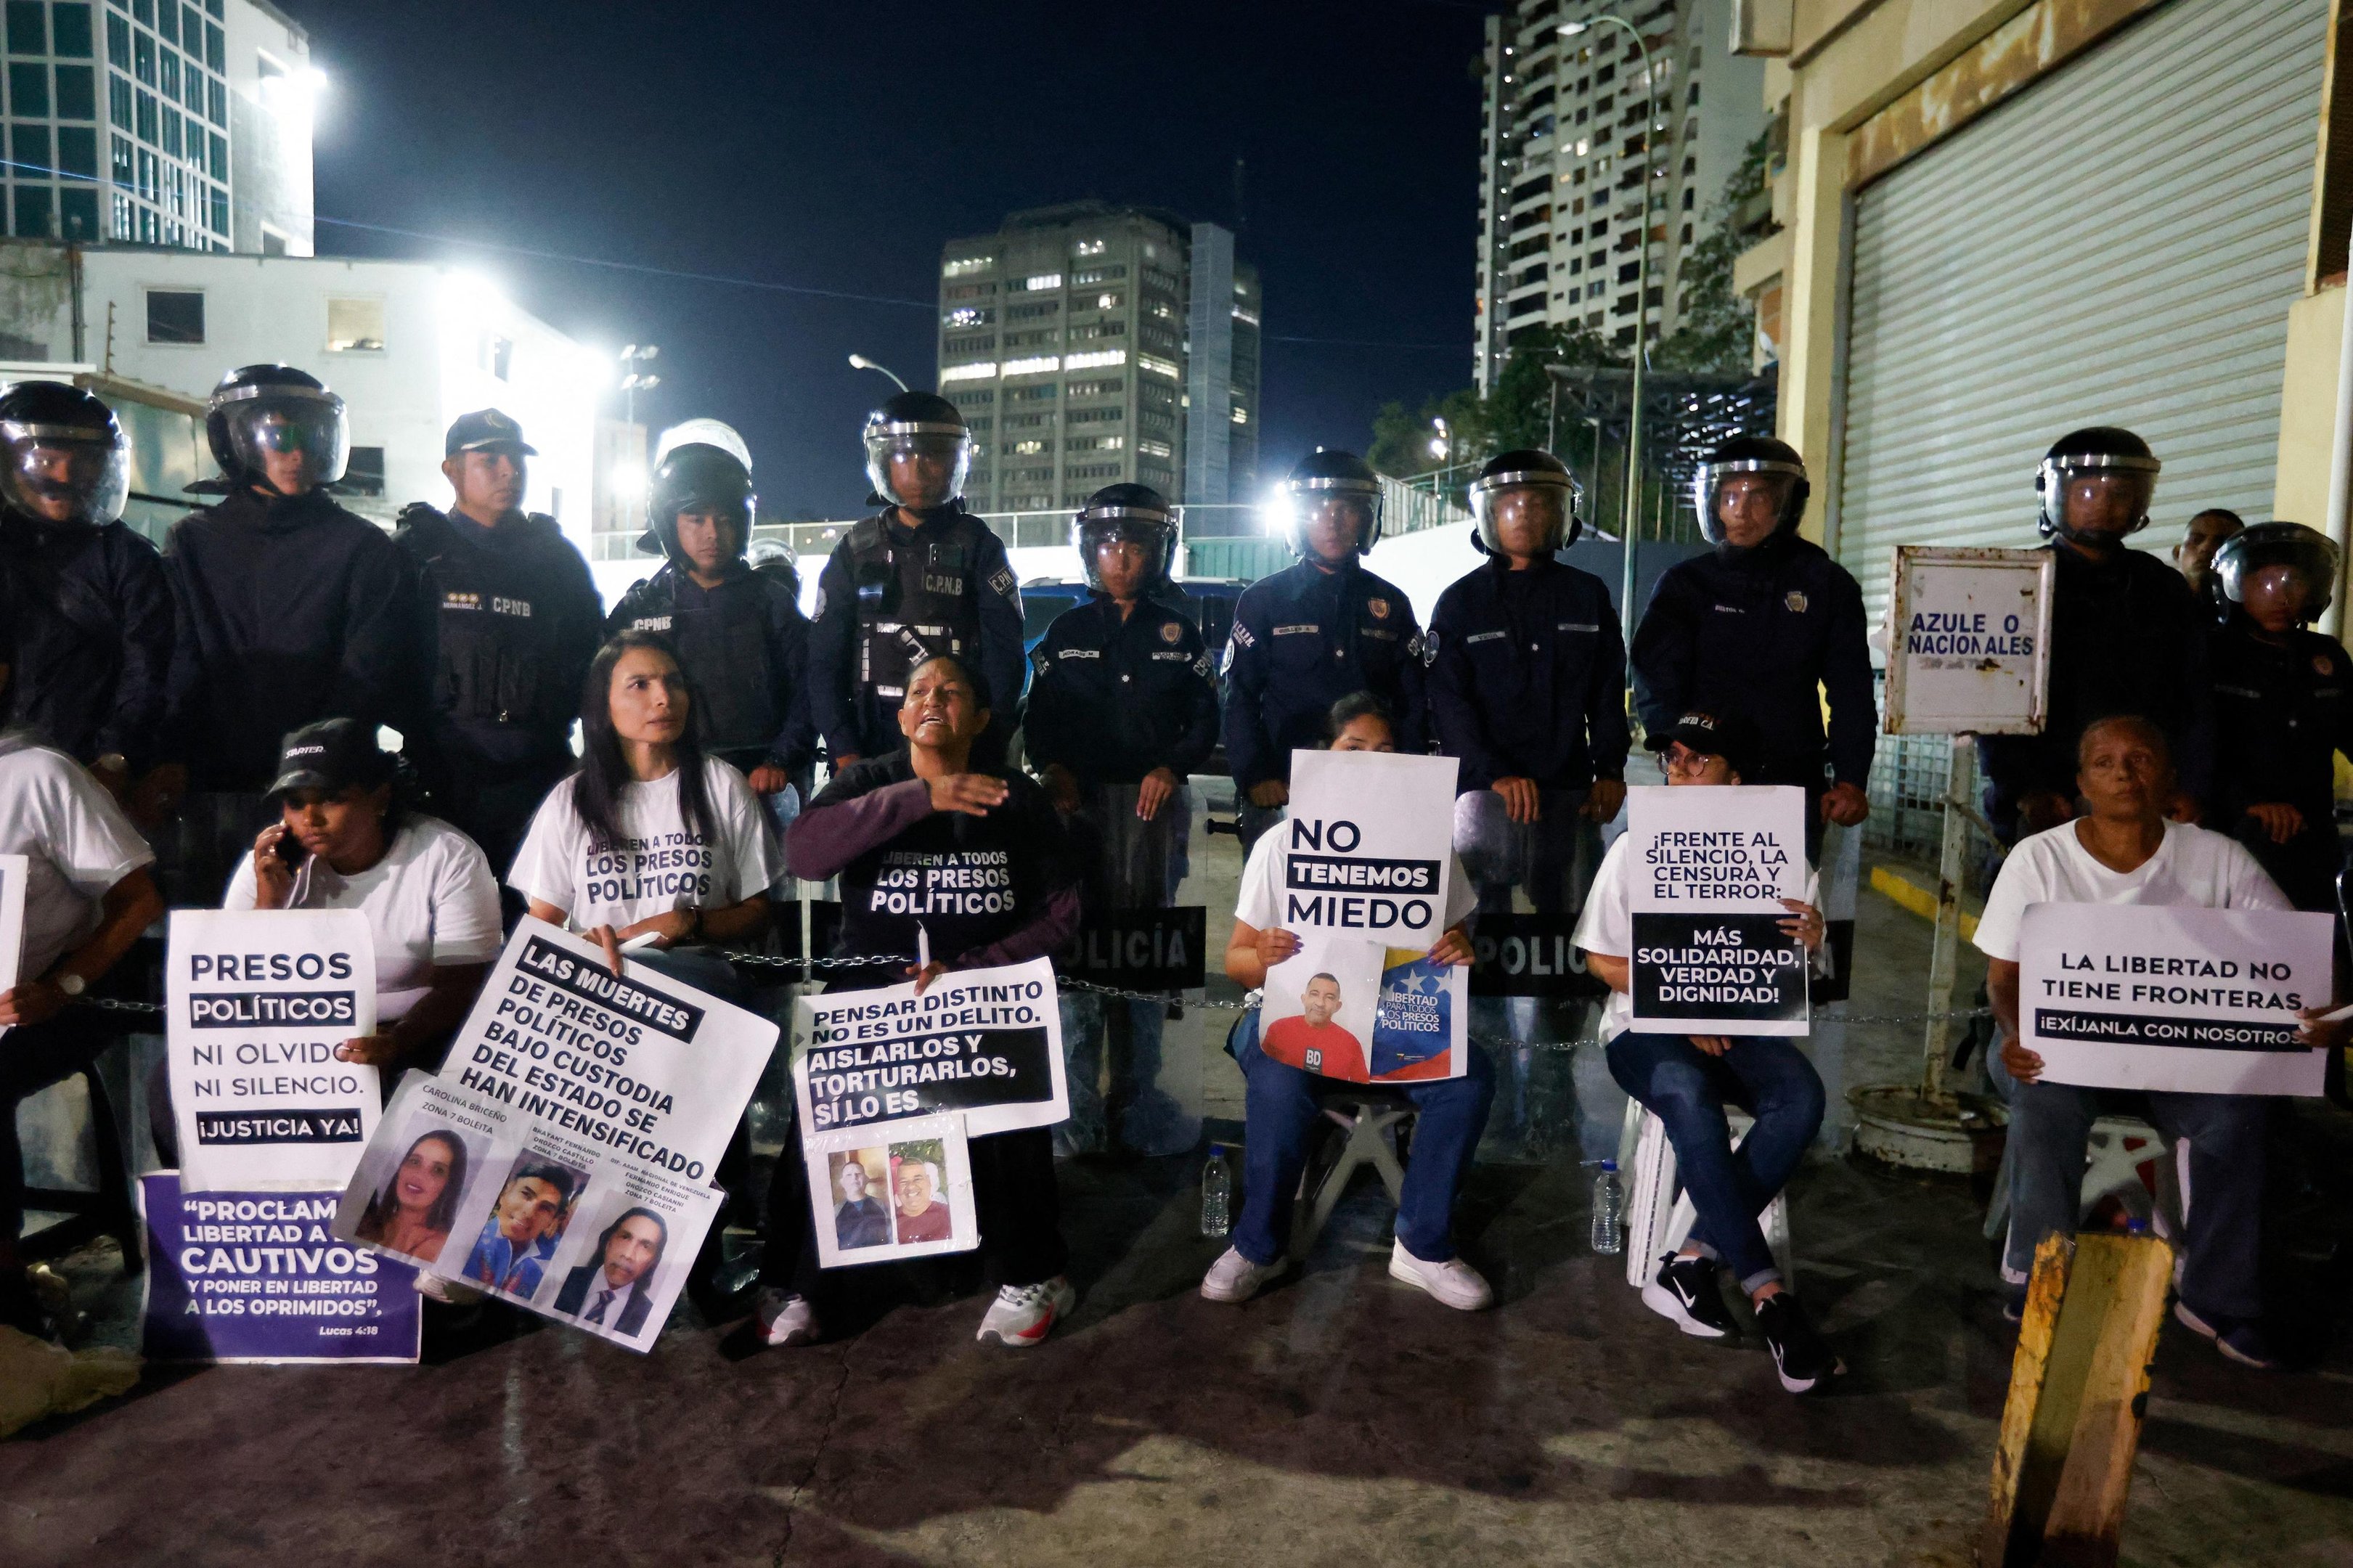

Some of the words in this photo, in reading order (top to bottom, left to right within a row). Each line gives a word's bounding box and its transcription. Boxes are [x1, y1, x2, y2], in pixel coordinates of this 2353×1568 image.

[926, 574, 963, 596] C.P.N.B
[494, 597, 531, 617] CPNB
[1911, 613, 1986, 633] AZULE
[2004, 615, 2019, 634] O
[285, 746, 324, 759] STARTER
[653, 836, 661, 848] A
[1292, 818, 1361, 852] NO
[1654, 832, 1744, 850] ¡FRENTE
[1751, 832, 1780, 846] AL
[587, 855, 627, 877] LOS
[635, 849, 712, 873] PRESOS
[947, 853, 958, 865] A
[962, 852, 1008, 865] TODOS
[1646, 849, 1753, 867] SILENCIO,
[1761, 849, 1788, 864] LA
[877, 868, 918, 888] LOS
[926, 867, 1010, 888] PRESOS
[1293, 862, 1429, 887] TENEMOS
[1655, 867, 1761, 881] CENSURA
[1766, 867, 1780, 881] Y
[588, 873, 711, 904] POLÍTICOS
[1655, 884, 1679, 899] EL
[1685, 884, 1781, 899] TERROR:
[871, 888, 1015, 914] POLÍTICOS
[1288, 894, 1432, 930] MIEDO
[1062, 922, 1188, 968] OLICÍA
[1694, 926, 1742, 945] MÁS
[192, 952, 352, 981] PRESOS
[1638, 948, 1799, 968] SOLIDARIDAD,
[2061, 952, 2095, 971] LA
[2105, 955, 2238, 979] LIBERTAD
[2250, 963, 2291, 981] NO
[1660, 967, 1755, 984] VERDAD
[1761, 968, 1777, 984] Y
[523, 944, 574, 980] LAS
[576, 970, 689, 1030] MUERTES
[1659, 986, 1779, 1003] DIGNIDAD!
[2042, 979, 2121, 1000] TIENE
[2132, 985, 2302, 1010] FRONTERAS
[192, 995, 352, 1021] POLÍTICOS
[508, 975, 546, 1004] DE
[546, 992, 643, 1045] PRESOS
[814, 1000, 916, 1027] PENSAR
[924, 981, 1043, 1012] DISTINTO
[1387, 1002, 1406, 1011] PARA
[1408, 1004, 1436, 1013] TODOS
[812, 1027, 850, 1045] NO
[857, 1022, 889, 1039] ES
[897, 1016, 932, 1034] UN
[941, 1005, 1040, 1028] DELITO.
[1382, 1018, 1440, 1032] POLÍTICOS
[1403, 1012, 1440, 1023] PRESOS
[2041, 1015, 2139, 1037] ¡EXÍJANLA
[2144, 1024, 2187, 1040] CON
[497, 997, 627, 1066] POLÍTICOS
[193, 1045, 222, 1065] NI
[809, 1037, 960, 1073] AISLARLOS
[964, 1034, 983, 1053] Y
[1306, 1049, 1321, 1066] BD
[484, 1021, 550, 1060] BAJO
[553, 1050, 673, 1114] CUSTODIA
[810, 1056, 1016, 1098] TORTURARLOS,
[195, 1079, 220, 1096] NI
[232, 1076, 363, 1095] SILENCIO.
[472, 1043, 518, 1078] DEL
[524, 1066, 622, 1119] ESTADO
[624, 1108, 658, 1134] SE
[423, 1085, 466, 1108] CAROLINA
[469, 1103, 507, 1122] BRICEÑO
[815, 1097, 840, 1125] SÍ
[845, 1097, 879, 1122] LO
[886, 1090, 919, 1114] ES
[200, 1119, 314, 1138] ¡JUSTICIA
[320, 1118, 359, 1135] YA!
[423, 1102, 447, 1117] ZONA
[457, 1115, 493, 1134] BOLEITA
[460, 1067, 518, 1103] HAN
[518, 1091, 704, 1180] INTENSIFICADO
[533, 1145, 551, 1156] ZONA
[534, 1137, 560, 1151] OROZCO
[562, 1148, 594, 1164] CASTILLO
[565, 1140, 600, 1158] FERNANDO
[625, 1172, 660, 1189] FERNANDO
[661, 1186, 690, 1201] ENRIQUE
[626, 1182, 653, 1195] OROZCO
[641, 1168, 669, 1183] NACIONAL
[679, 1185, 710, 1200] VENEZUELA
[184, 1200, 337, 1221] “PROCLAM
[625, 1190, 643, 1199] ZONA
[649, 1199, 677, 1213] BOLEITA
[184, 1225, 302, 1242] LIBERTAD
[309, 1225, 327, 1242] A
[181, 1247, 378, 1274] CAUTIVOS
[187, 1281, 199, 1293] Y
[204, 1281, 261, 1293] PONER
[266, 1281, 288, 1293] EN
[293, 1281, 378, 1294] LIBERTAD
[184, 1299, 200, 1315] A
[206, 1299, 245, 1315] LOS
[319, 1326, 353, 1336] Lucas
[355, 1326, 378, 1335] 4:18
